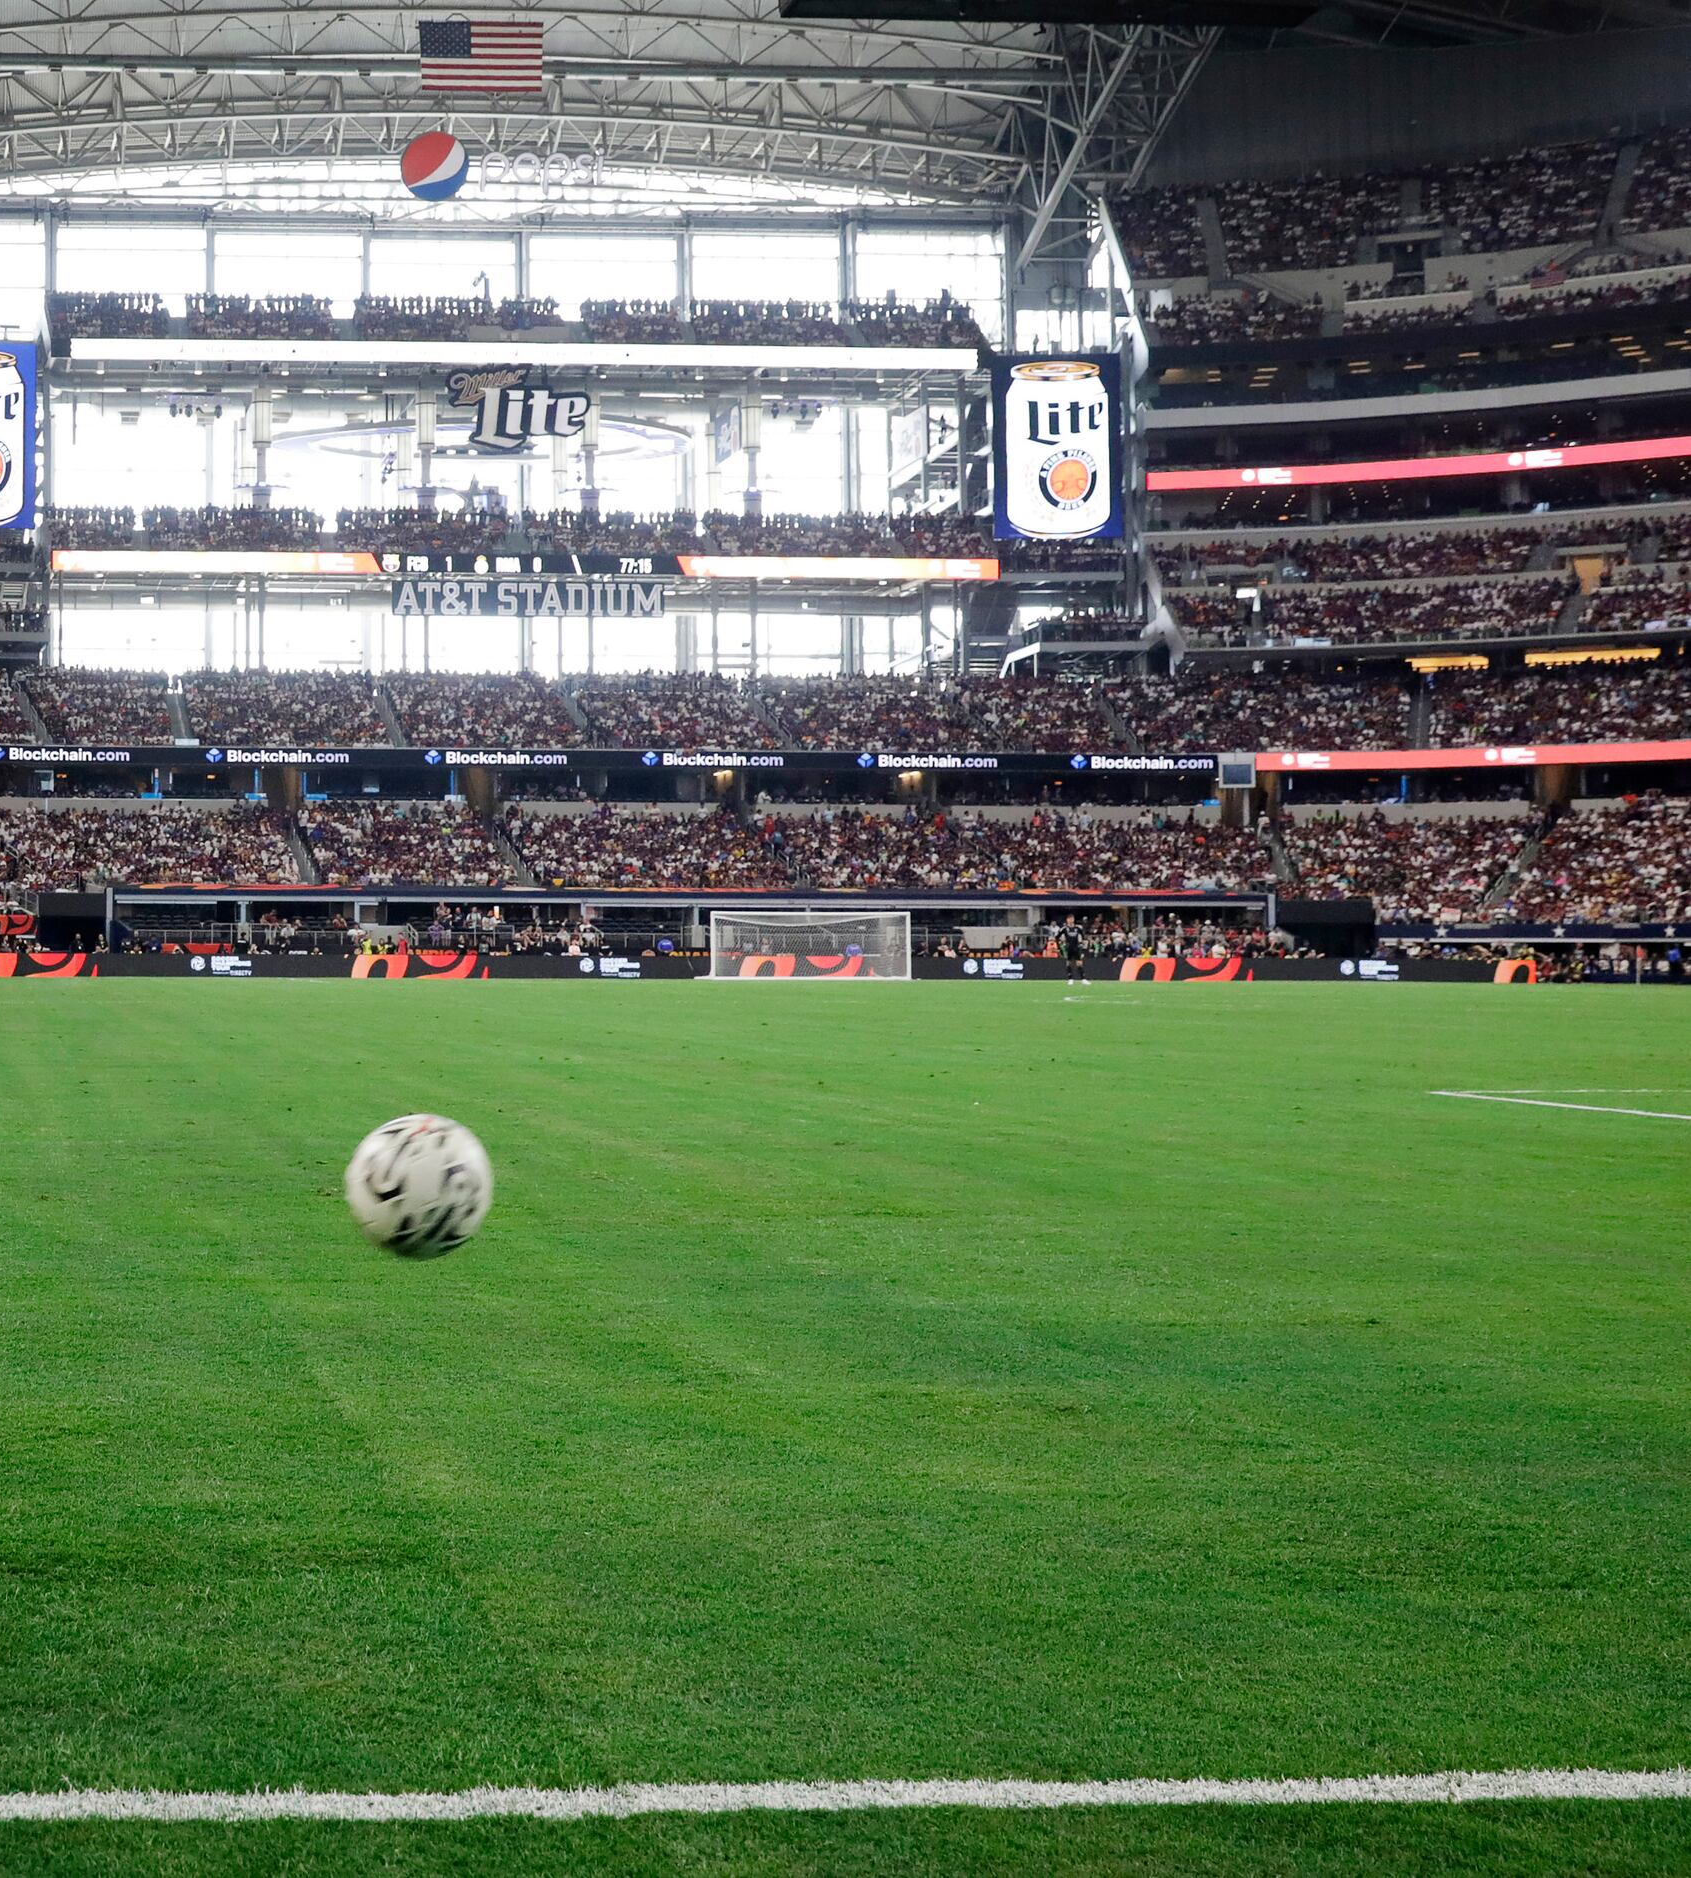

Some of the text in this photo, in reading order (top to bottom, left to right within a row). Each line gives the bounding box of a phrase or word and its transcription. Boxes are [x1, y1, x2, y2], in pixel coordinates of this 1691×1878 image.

[479, 148, 605, 195] pepsi
[450, 369, 527, 405] Miller
[473, 387, 589, 449] Lite
[1026, 400, 1104, 446] Lite
[445, 556, 452, 572] 1
[394, 582, 663, 617] AT&T STADIUM
[9, 748, 130, 762] Blockchain.com
[227, 749, 350, 763] Blockchain.com
[445, 751, 567, 765] Blockchain.com
[662, 752, 784, 767] Blockchain.com
[878, 754, 998, 768] Blockchain.com
[1090, 755, 1214, 770] Blockchain.com
